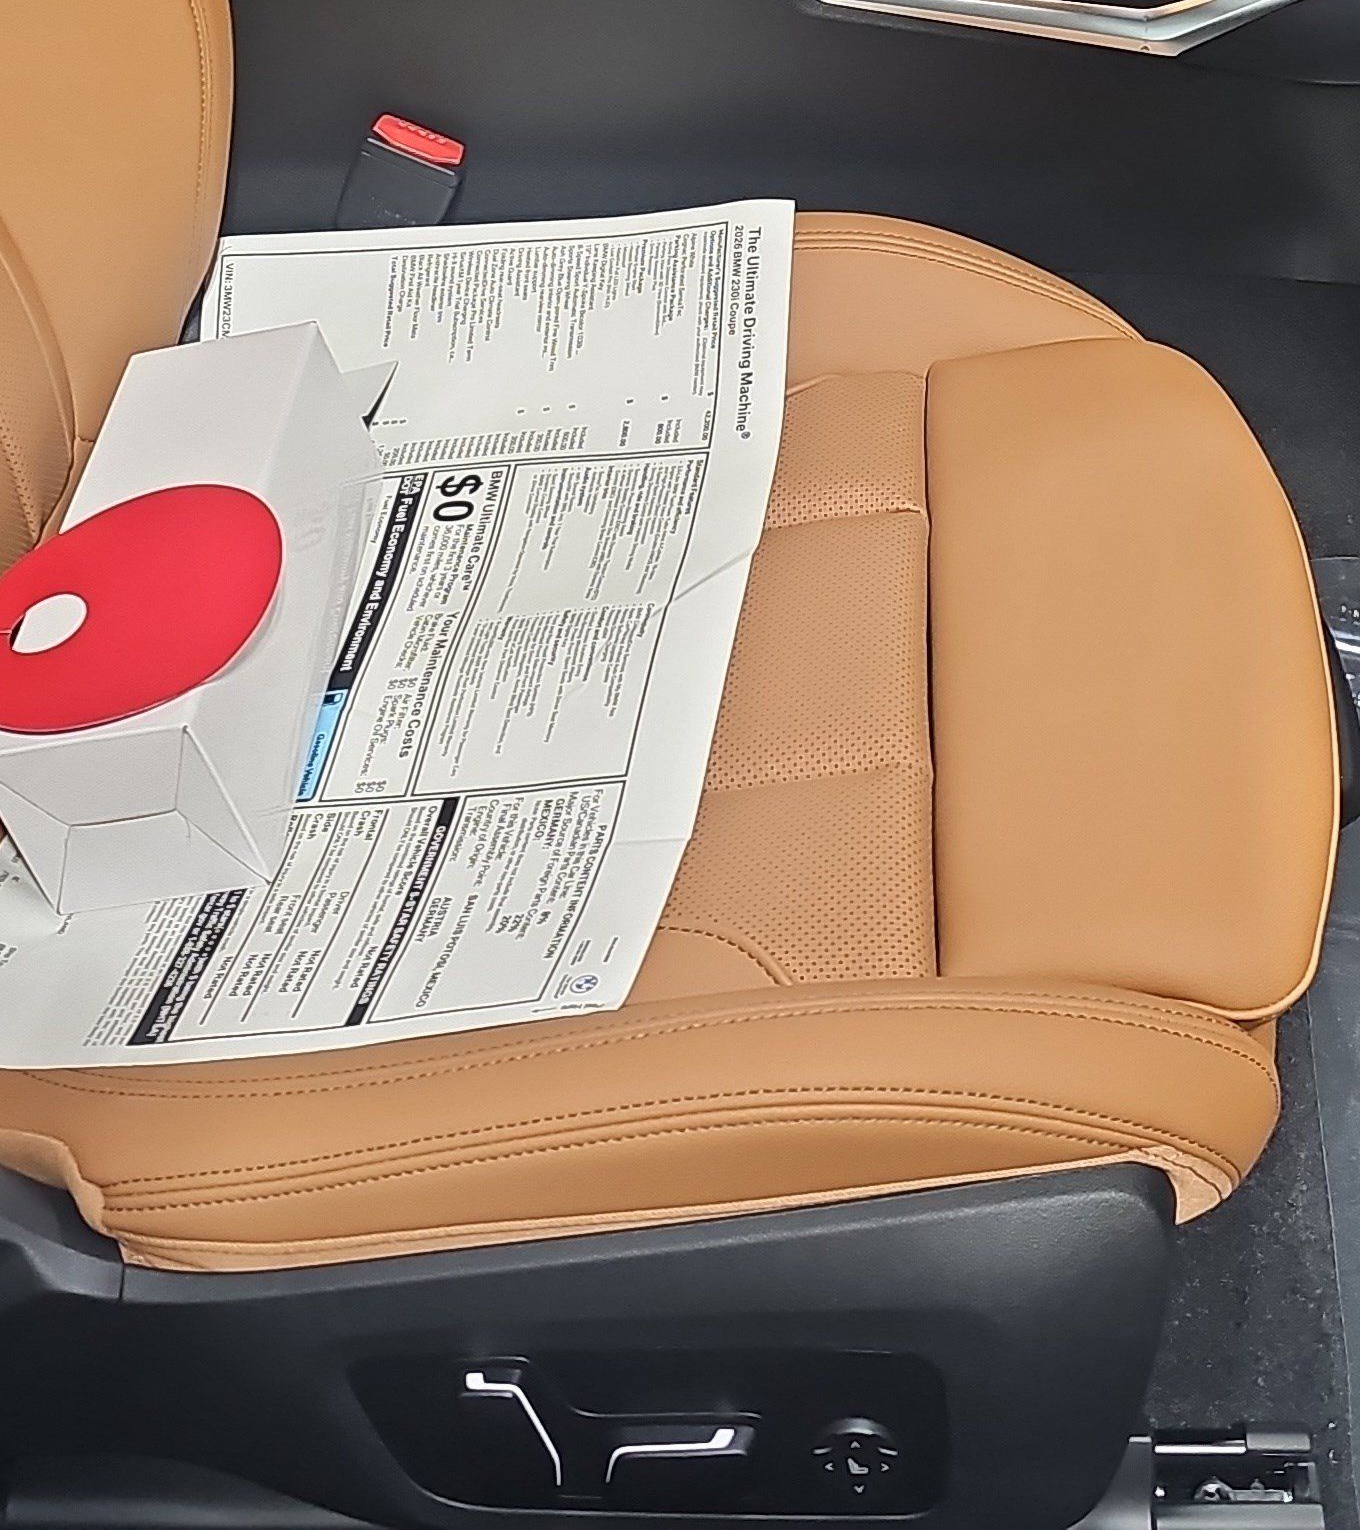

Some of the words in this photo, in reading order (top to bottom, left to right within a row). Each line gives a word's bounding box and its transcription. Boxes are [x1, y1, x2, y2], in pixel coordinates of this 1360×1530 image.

[708, 231, 716, 253] Options
[734, 225, 744, 249] 2026
[748, 227, 761, 253] The
[225, 263, 234, 283] VIN:
[732, 252, 741, 277] BMW
[385, 275, 396, 309] Suggested
[712, 277, 721, 310] Suggested
[731, 280, 740, 301] 230i
[743, 256, 760, 314] Ultimate
[728, 303, 737, 335] Coupe
[739, 319, 755, 368] Driving
[400, 476, 412, 495] DOT
[409, 475, 424, 493] EPA
[485, 471, 502, 501] BMW
[691, 460, 703, 487] Standard
[395, 498, 413, 521] Fuel
[433, 475, 484, 521] $0
[685, 489, 697, 514] Features
[370, 512, 387, 543] Economy
[427, 526, 441, 549] comes
[438, 525, 453, 550] 36,000
[455, 525, 464, 537] For
[471, 504, 495, 553] Ultimate
[376, 525, 404, 577] Economy
[409, 526, 430, 575] maintenance.
[451, 538, 460, 549] the
[452, 524, 474, 572] Maintenance
[422, 551, 435, 564] first
[430, 552, 446, 572] miles,
[370, 580, 385, 600] and
[407, 577, 425, 611] scheduled
[419, 574, 439, 608] whichever
[440, 574, 458, 604] Program
[407, 615, 424, 639] Vehicle
[419, 614, 434, 633] Cabin
[428, 613, 443, 632] Brake
[440, 611, 460, 636] Your
[340, 602, 379, 671] Environment
[387, 680, 397, 690] $0
[397, 679, 408, 689] $0
[407, 677, 418, 688] $0
[411, 639, 449, 716] Maintenance
[376, 695, 391, 723] Engine
[388, 695, 402, 718] Spark
[401, 694, 412, 704] Air
[372, 724, 383, 736] Oil
[380, 720, 395, 745] Plugs:
[399, 719, 420, 758] Costs
[305, 734, 325, 767] Gasoline
[360, 738, 378, 776] Services:
[298, 769, 313, 796] Vehicle
[355, 782, 365, 793] $0
[365, 781, 376, 792] $0
[376, 780, 386, 792] $0
[511, 797, 524, 813] For
[562, 791, 579, 817] Major
[592, 789, 603, 803] For
[321, 813, 336, 833] Side
[353, 810, 370, 837] Crash
[365, 810, 383, 841] Frontal
[419, 806, 438, 836] Overall
[478, 799, 499, 832] Country
[497, 803, 511, 823] Final
[507, 814, 520, 828] this
[533, 799, 553, 841] MEXICO:
[542, 798, 565, 850] GERMANY:
[568, 795, 590, 850] US/Canadian
[581, 805, 599, 841] Vehicles
[307, 814, 323, 840] Crash
[555, 819, 572, 848] Source
[589, 825, 607, 855] PARTS
[407, 838, 426, 869] Vehicle
[482, 825, 506, 863] Assembly
[495, 830, 514, 861] Vehicle:
[574, 850, 586, 864] this
[414, 826, 447, 890] GOVERNMENT
[559, 852, 575, 870] Parts
[395, 871, 413, 896] Score
[539, 858, 558, 886] Foreign
[568, 866, 581, 879] Car
[572, 856, 596, 897] CONTENT
[272, 896, 288, 914] Rear
[284, 895, 301, 916] Front
[332, 892, 350, 915] Driver
[396, 891, 421, 925] 5-STAR
[461, 894, 479, 914] SAN
[530, 888, 547, 907] Parts
[310, 892, 337, 934] Passenger
[415, 898, 441, 942] GERMANY
[428, 897, 453, 936] AUSTRIA
[452, 916, 470, 935] LUIS
[508, 914, 524, 932] 22%
[544, 899, 578, 959] INFORMATION
[308, 950, 322, 965] Not
[366, 946, 378, 961] Not
[378, 927, 405, 962] SAFETY
[220, 956, 233, 971] Not
[245, 954, 258, 969] Not
[259, 954, 273, 969] Not
[294, 951, 308, 966] Not
[203, 973, 225, 999] Rated
[229, 971, 250, 997] Rated
[243, 970, 264, 996] Rated
[279, 967, 301, 993] Rated
[292, 967, 314, 992] Rated
[350, 962, 371, 988] Rated
[358, 964, 388, 1005] RATINGS
[415, 972, 441, 1008] MEXICO
